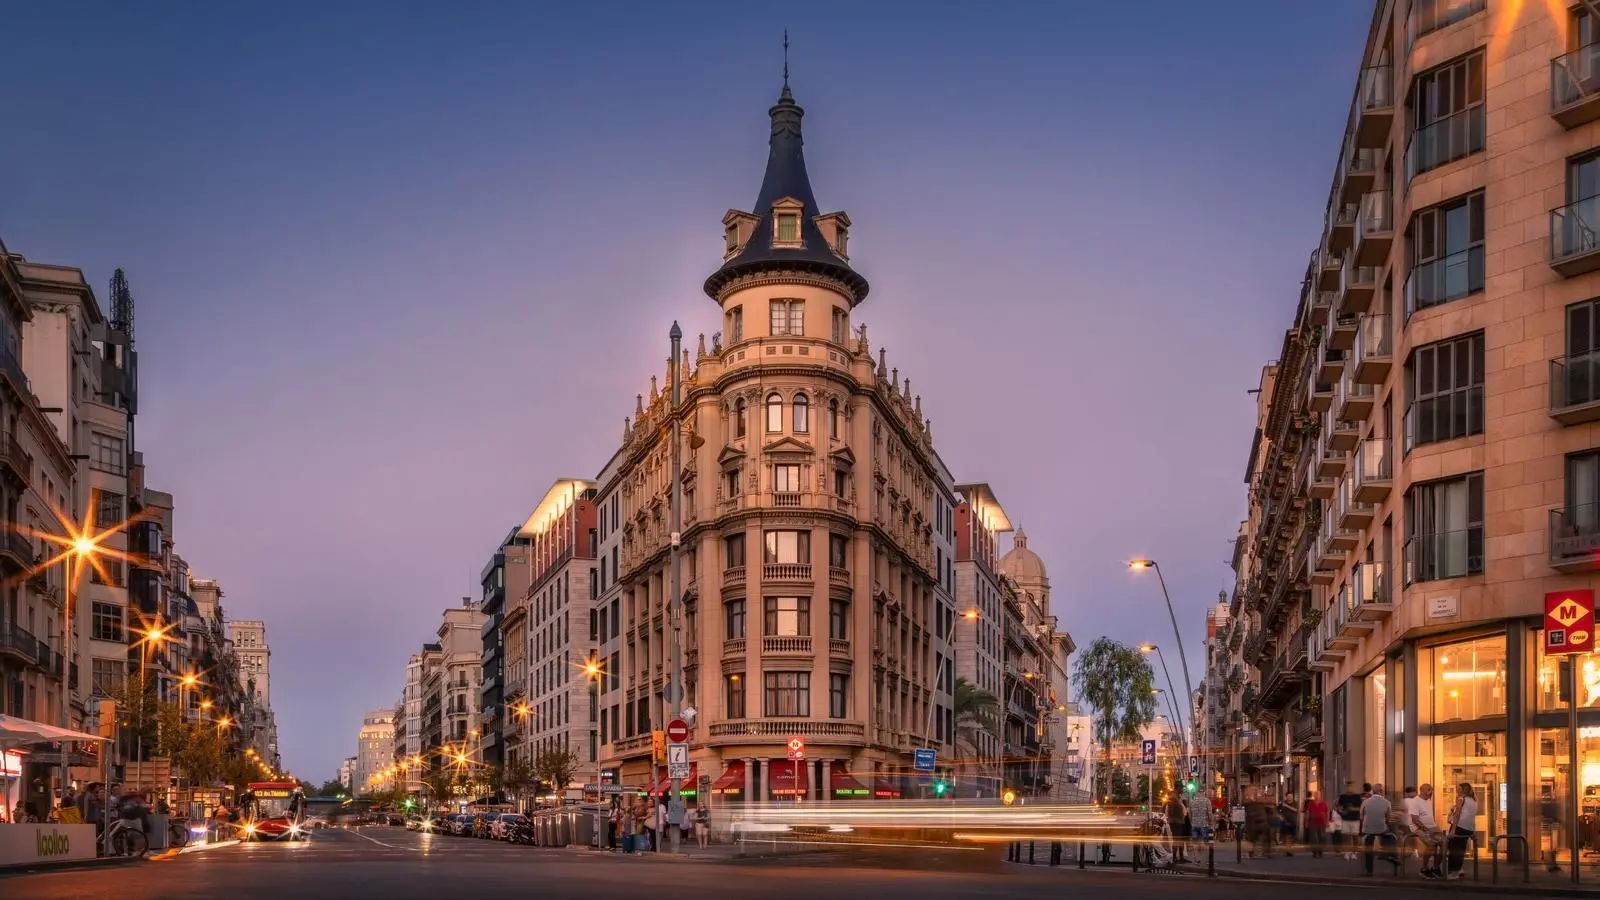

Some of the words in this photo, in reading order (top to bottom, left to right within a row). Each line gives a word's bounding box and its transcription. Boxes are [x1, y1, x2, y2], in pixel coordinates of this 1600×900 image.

[1560, 606, 1576, 619] M
[1145, 743, 1152, 752] P
[1192, 758, 1196, 771] P
